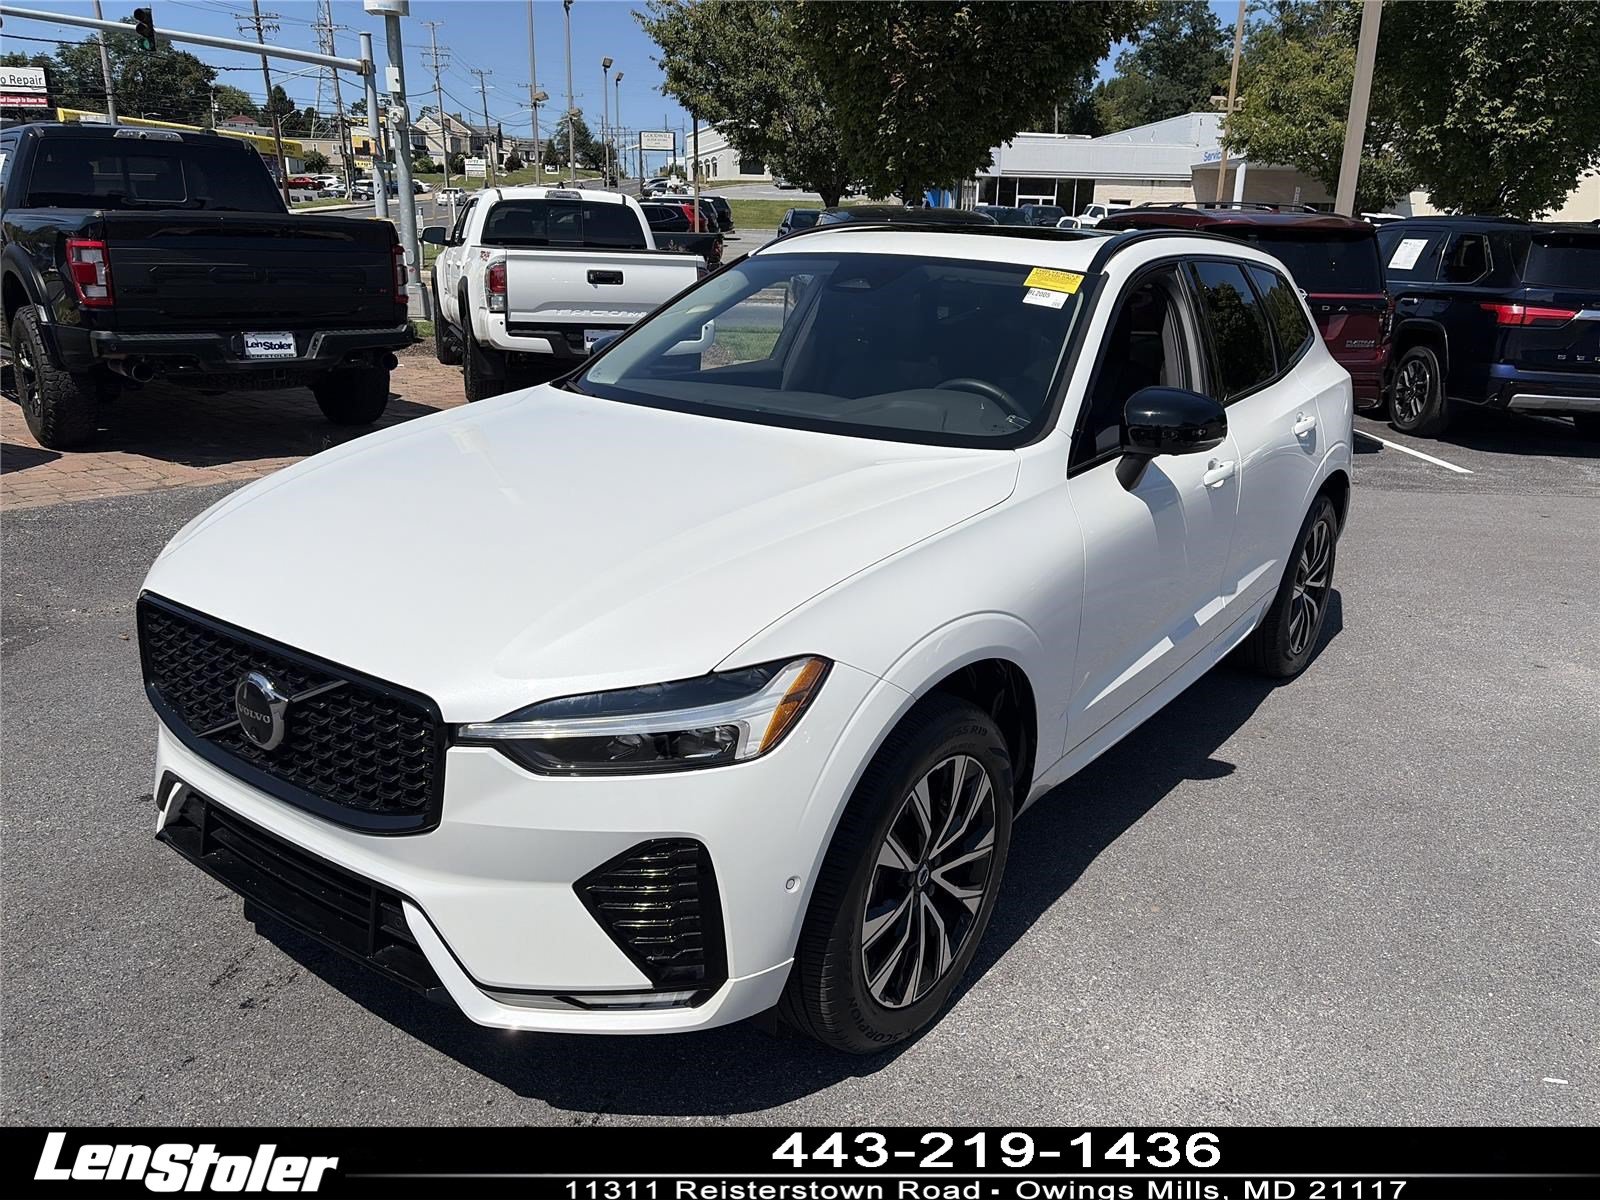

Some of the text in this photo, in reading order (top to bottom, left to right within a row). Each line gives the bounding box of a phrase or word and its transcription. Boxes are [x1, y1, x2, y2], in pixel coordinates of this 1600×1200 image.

[9, 75, 42, 85] Repair
[1203, 150, 1222, 162] Servic
[238, 703, 271, 724] VOLVO
[847, 996, 902, 1042] SCORPION
